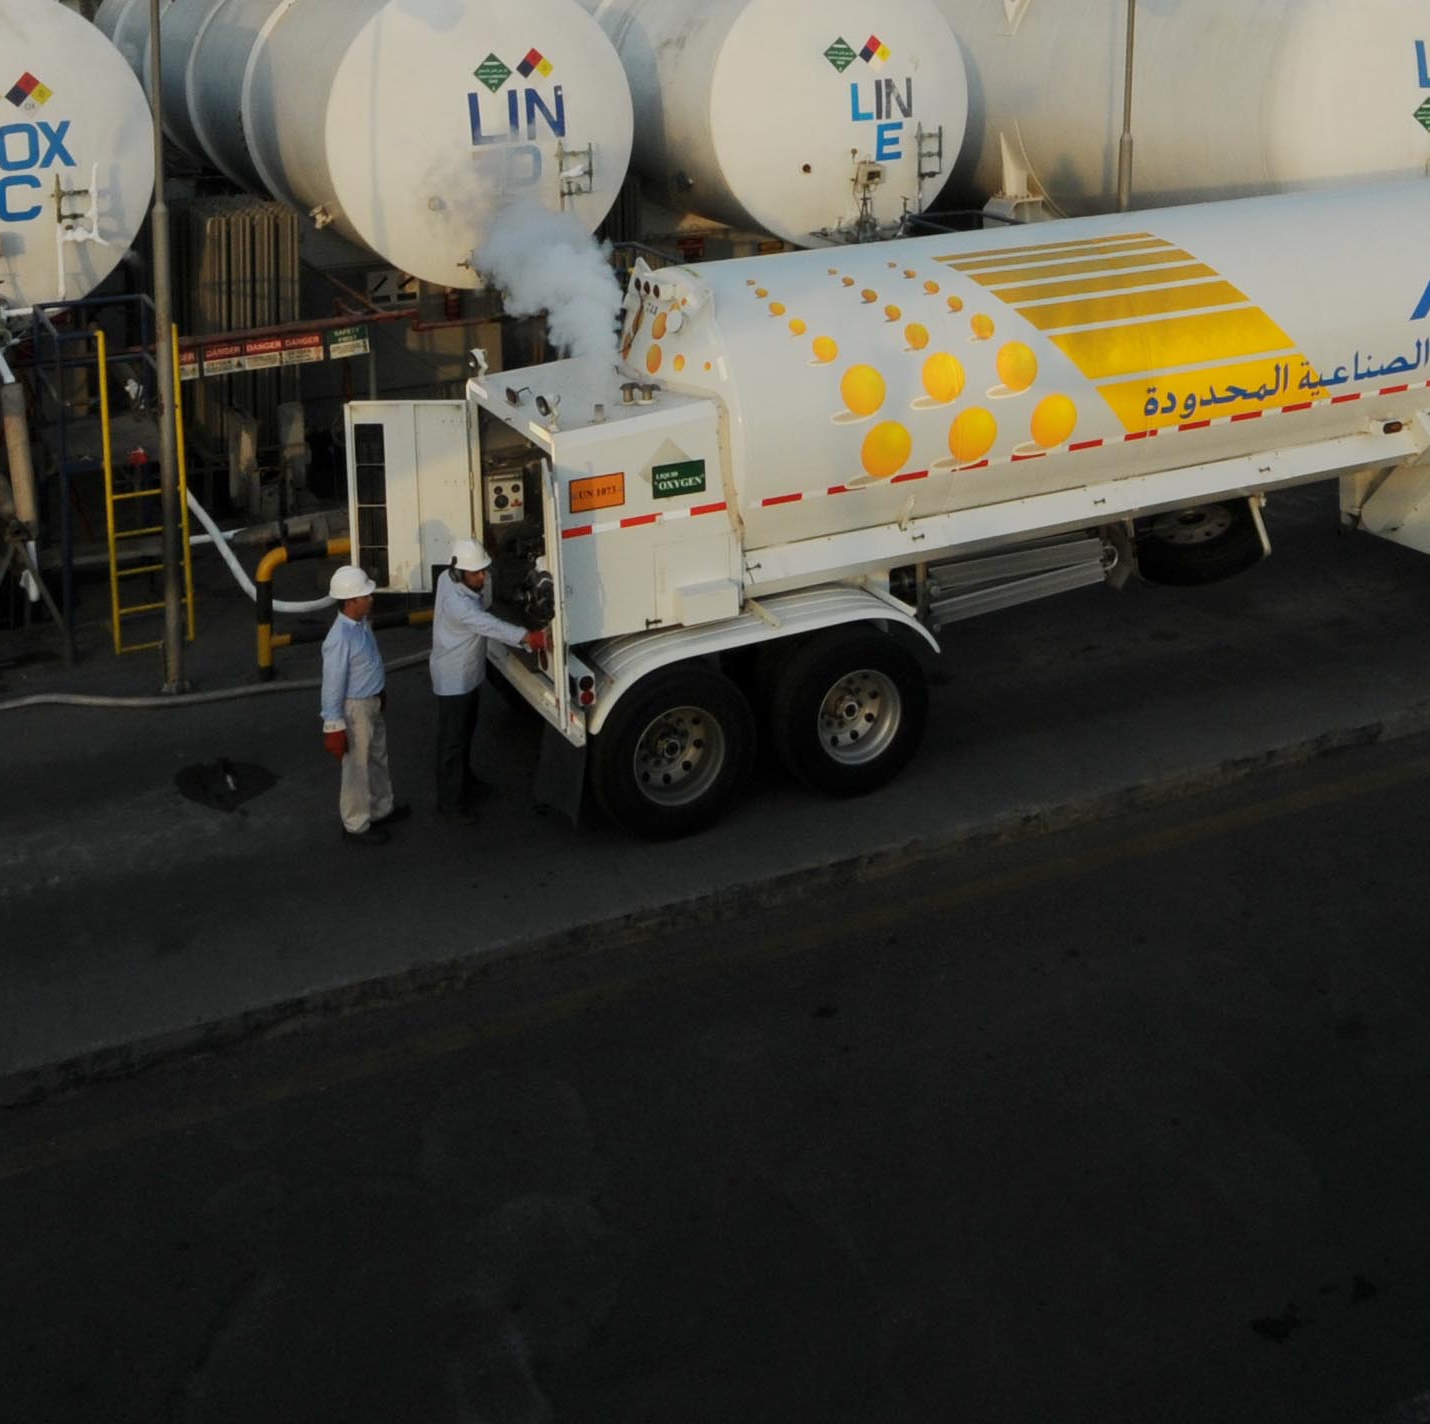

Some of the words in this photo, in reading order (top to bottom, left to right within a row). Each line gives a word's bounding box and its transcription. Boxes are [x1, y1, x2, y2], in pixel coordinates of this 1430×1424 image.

[851, 77, 913, 122] LIN
[468, 85, 566, 146] LIN
[876, 121, 903, 162] E
[246, 340, 281, 352] DANGER
[284, 335, 320, 346] DANGER
[205, 345, 241, 358] DANGER
[1298, 336, 1430, 396] الصناعية
[1144, 362, 1289, 419] المحدودة
[655, 471, 679, 480] LIQUID
[658, 477, 703, 491] OXYGEN
[578, 489, 594, 500] UN
[596, 486, 616, 497] 1073
